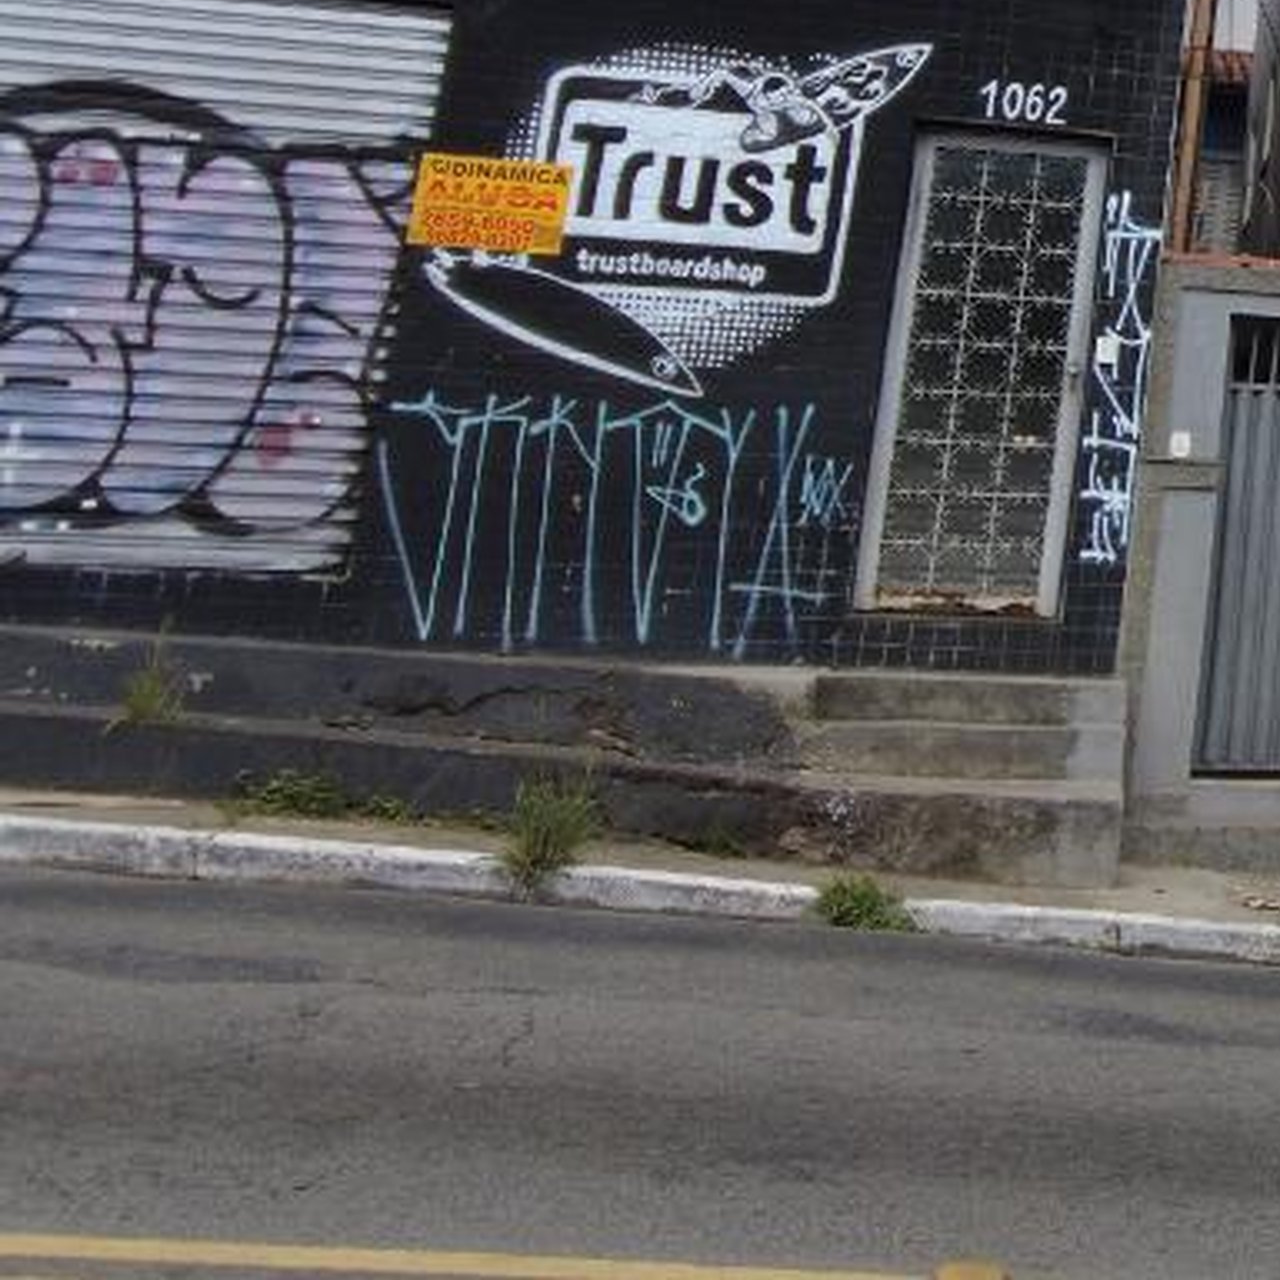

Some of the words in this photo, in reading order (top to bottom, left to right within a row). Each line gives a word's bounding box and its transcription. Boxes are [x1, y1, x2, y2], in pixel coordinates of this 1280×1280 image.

[981, 79, 1068, 125] 1062
[571, 122, 827, 236] Trust
[575, 248, 767, 287] trustboardshop
